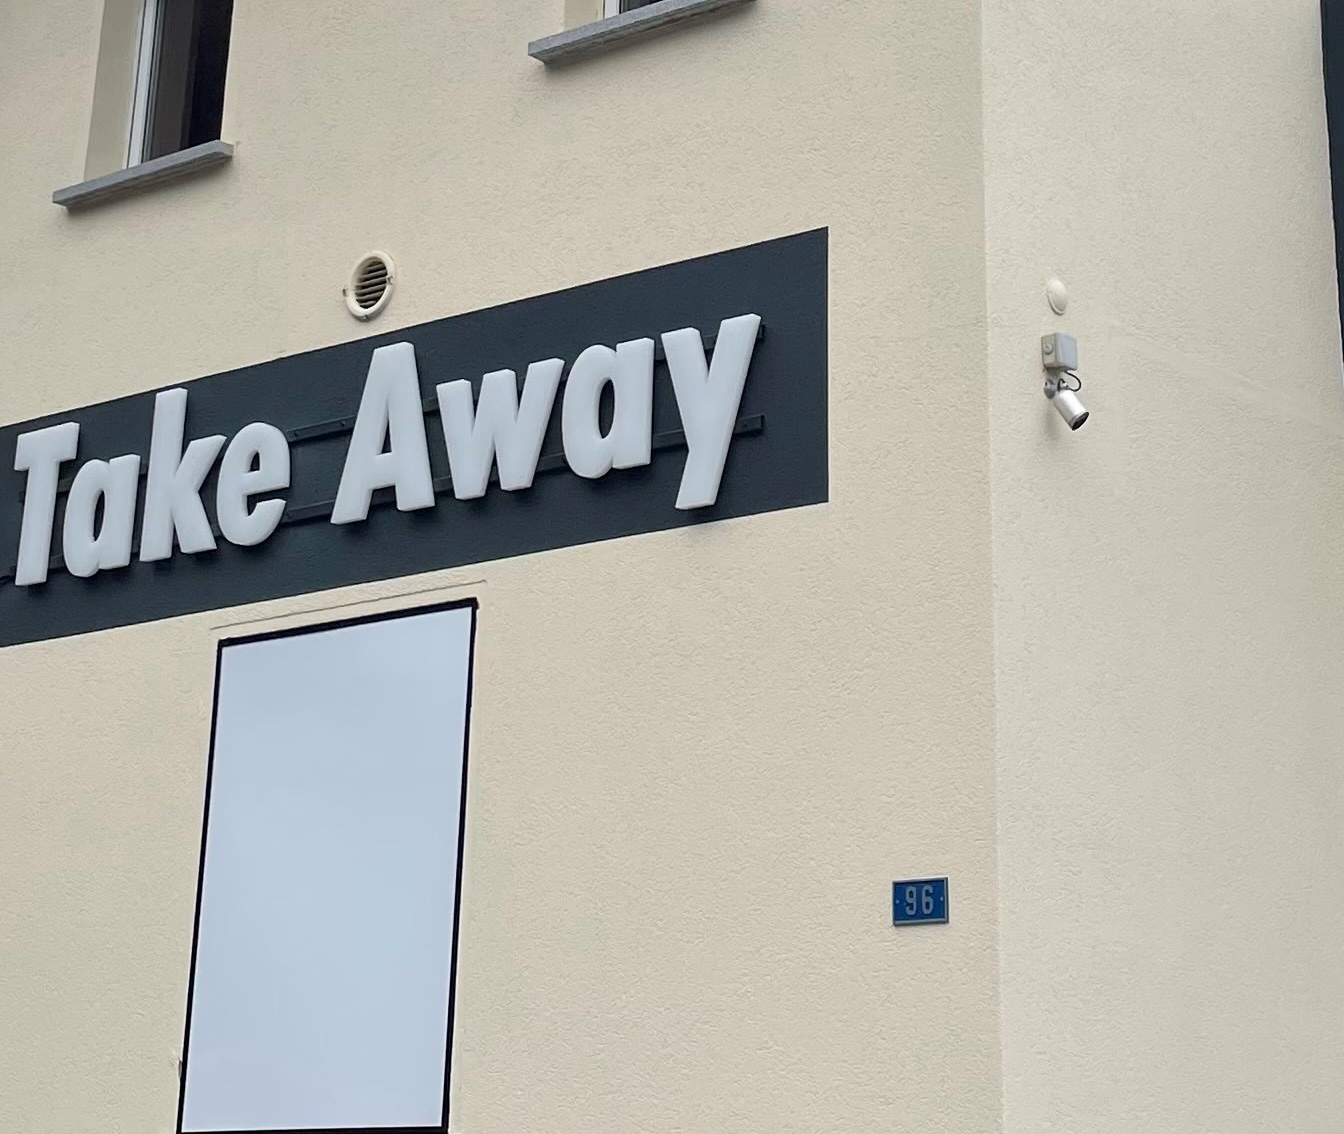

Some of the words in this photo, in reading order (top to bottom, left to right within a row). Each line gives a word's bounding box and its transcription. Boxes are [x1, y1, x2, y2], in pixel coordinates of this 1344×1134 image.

[14, 386, 291, 586] Take
[331, 312, 762, 525] Away
[905, 884, 934, 916] 96
